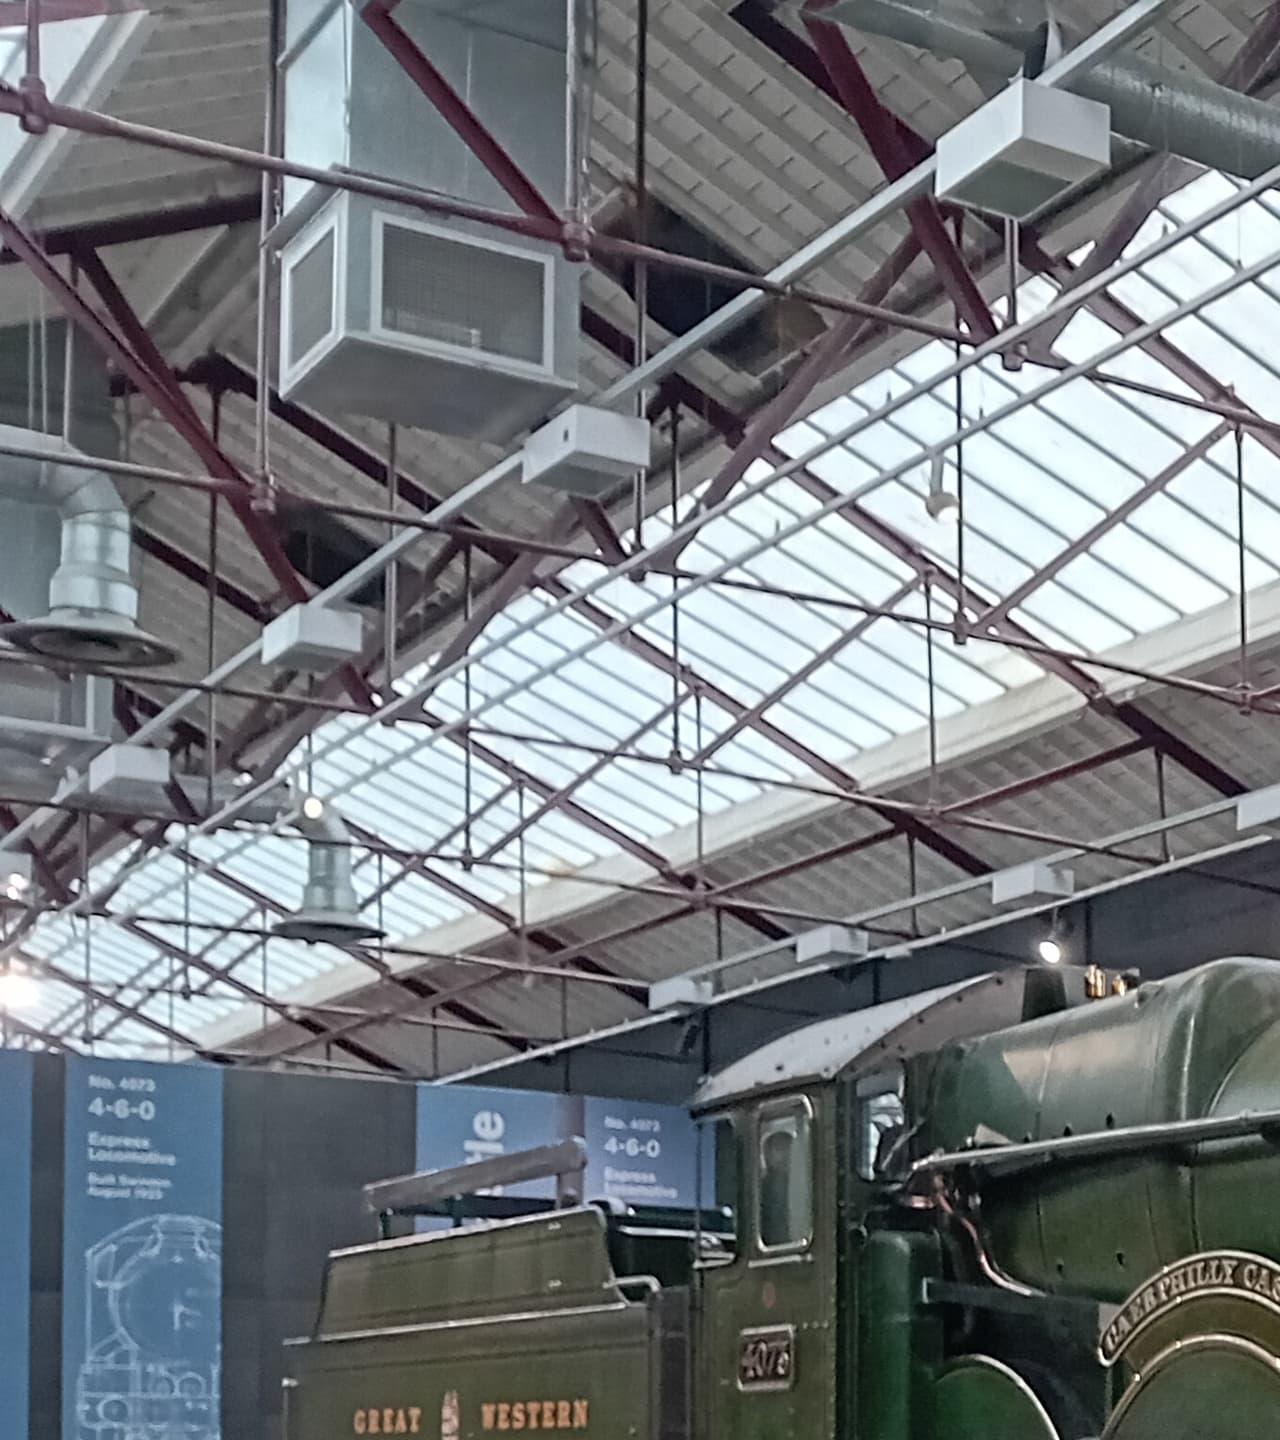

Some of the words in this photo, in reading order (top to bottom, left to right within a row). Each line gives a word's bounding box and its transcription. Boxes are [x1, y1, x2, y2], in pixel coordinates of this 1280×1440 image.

[88, 1097, 155, 1120] 4-6-0
[604, 1136, 660, 1158] 4-6-0
[1105, 1260, 1239, 1351] CAERPHILLY
[354, 1407, 421, 1434] GREAT
[481, 1399, 588, 1430] WESTERN
